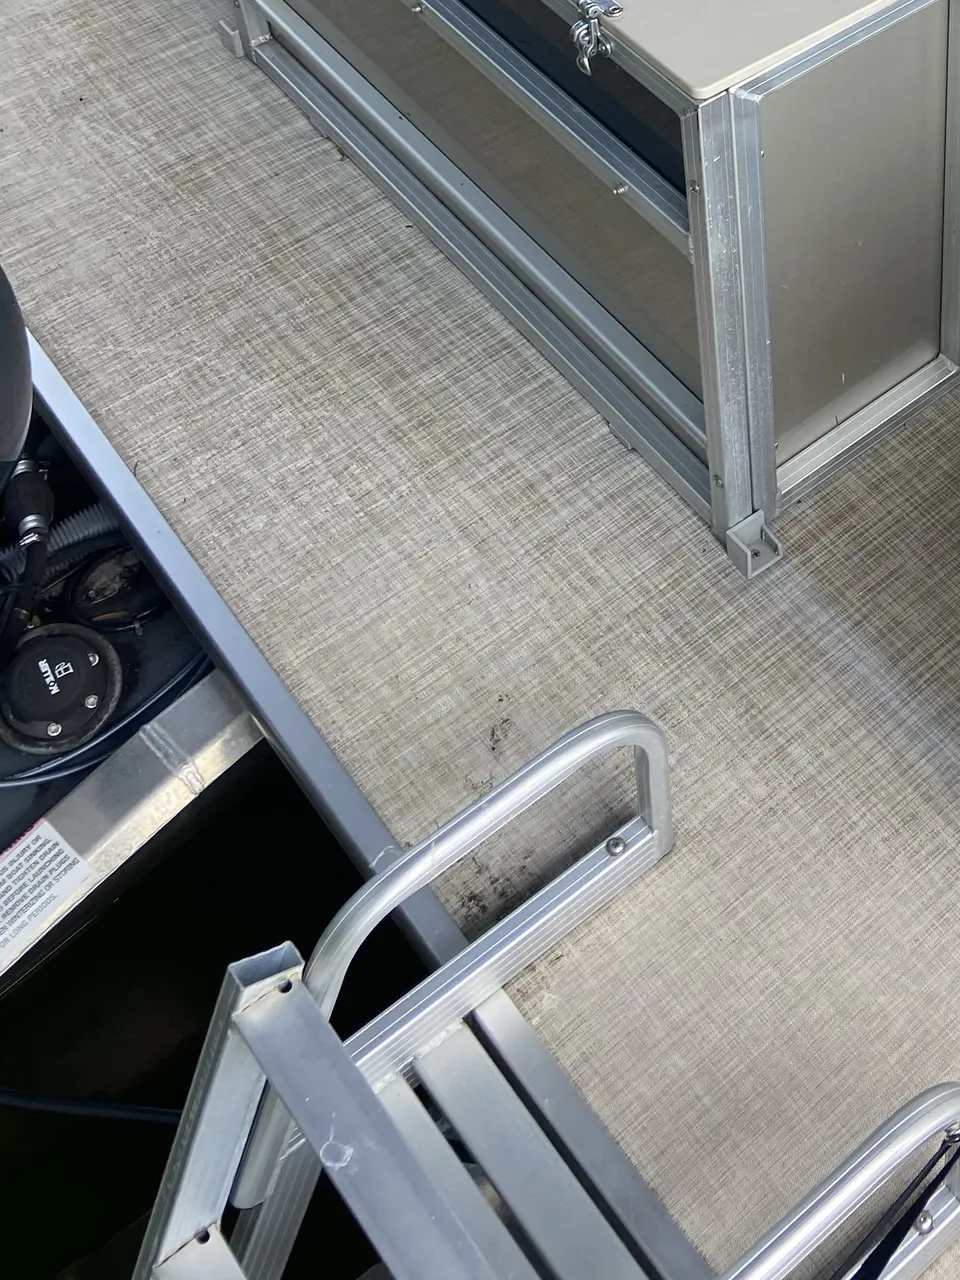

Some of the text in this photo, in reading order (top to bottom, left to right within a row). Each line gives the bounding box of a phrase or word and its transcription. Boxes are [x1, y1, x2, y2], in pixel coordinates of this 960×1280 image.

[6, 861, 24, 880] BOAT
[8, 843, 31, 867] INJURY
[31, 835, 42, 846] OR
[11, 860, 39, 886] TIGHTEN
[39, 841, 60, 861] DRAIN
[1, 893, 29, 920] REMOVE
[28, 873, 49, 894] DRAIN
[49, 854, 70, 875] PLUGS
[3, 848, 64, 906] BEFORE LAUNCHING
[6, 889, 46, 927] WINTERIZING
[53, 857, 80, 883] STORING
[9, 920, 29, 939] LONG
